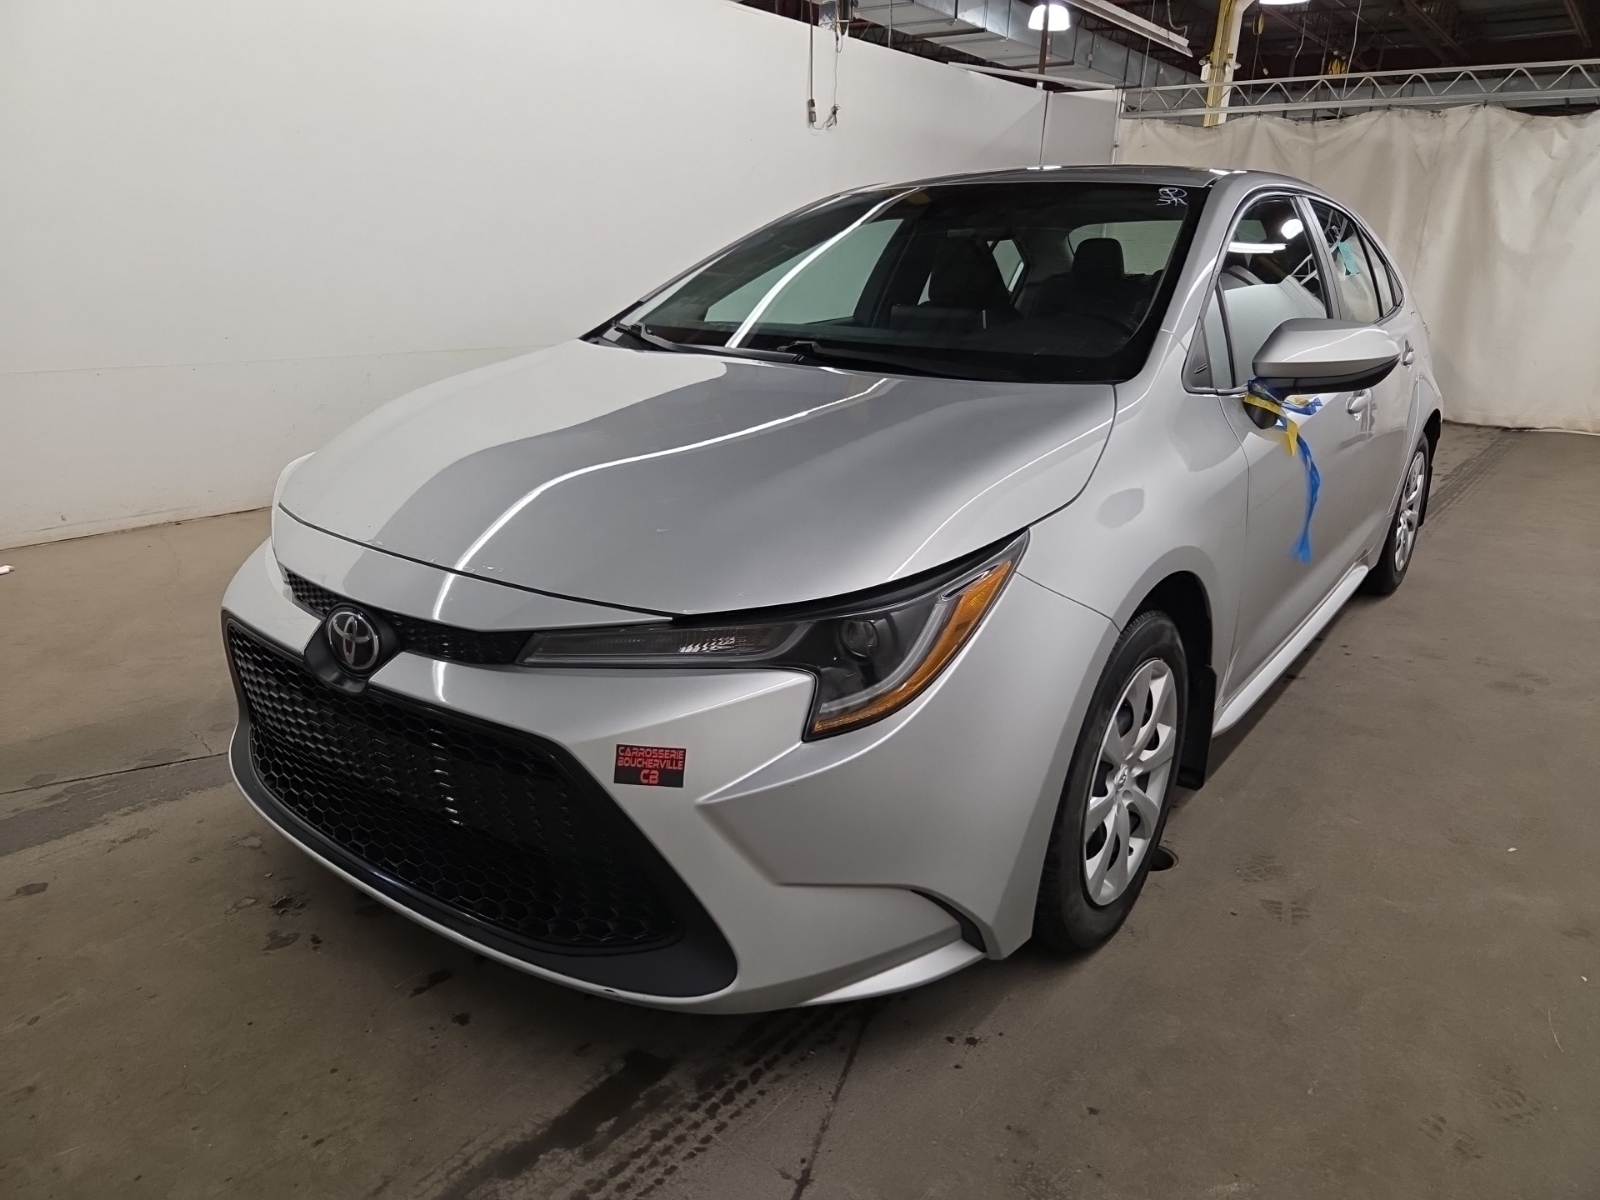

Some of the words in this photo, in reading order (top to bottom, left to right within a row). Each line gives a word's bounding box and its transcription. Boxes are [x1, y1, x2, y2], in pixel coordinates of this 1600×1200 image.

[618, 746, 684, 760] CARROSSERIE
[617, 757, 684, 770] BOUCHERVILLE
[640, 769, 659, 785] CB
